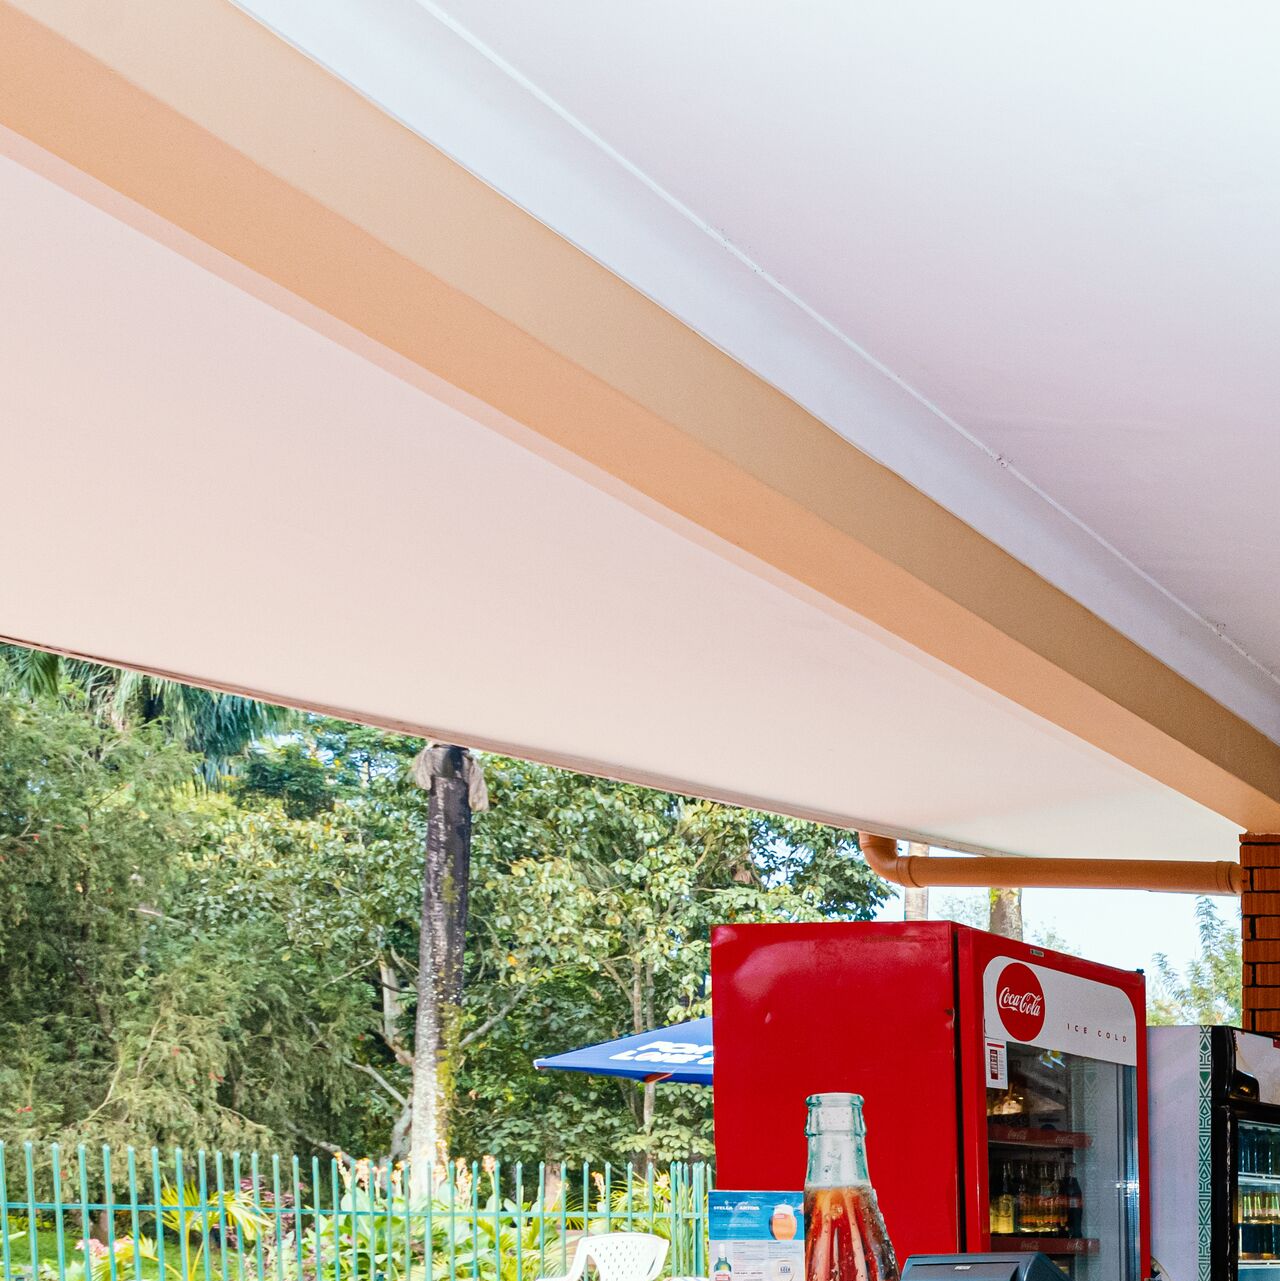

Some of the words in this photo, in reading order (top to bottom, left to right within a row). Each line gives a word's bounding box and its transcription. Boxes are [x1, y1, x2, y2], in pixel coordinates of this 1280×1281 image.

[999, 986, 1043, 1017] Coca-Cola
[1067, 1023, 1088, 1035] ICE
[1097, 1030, 1127, 1043] COLD
